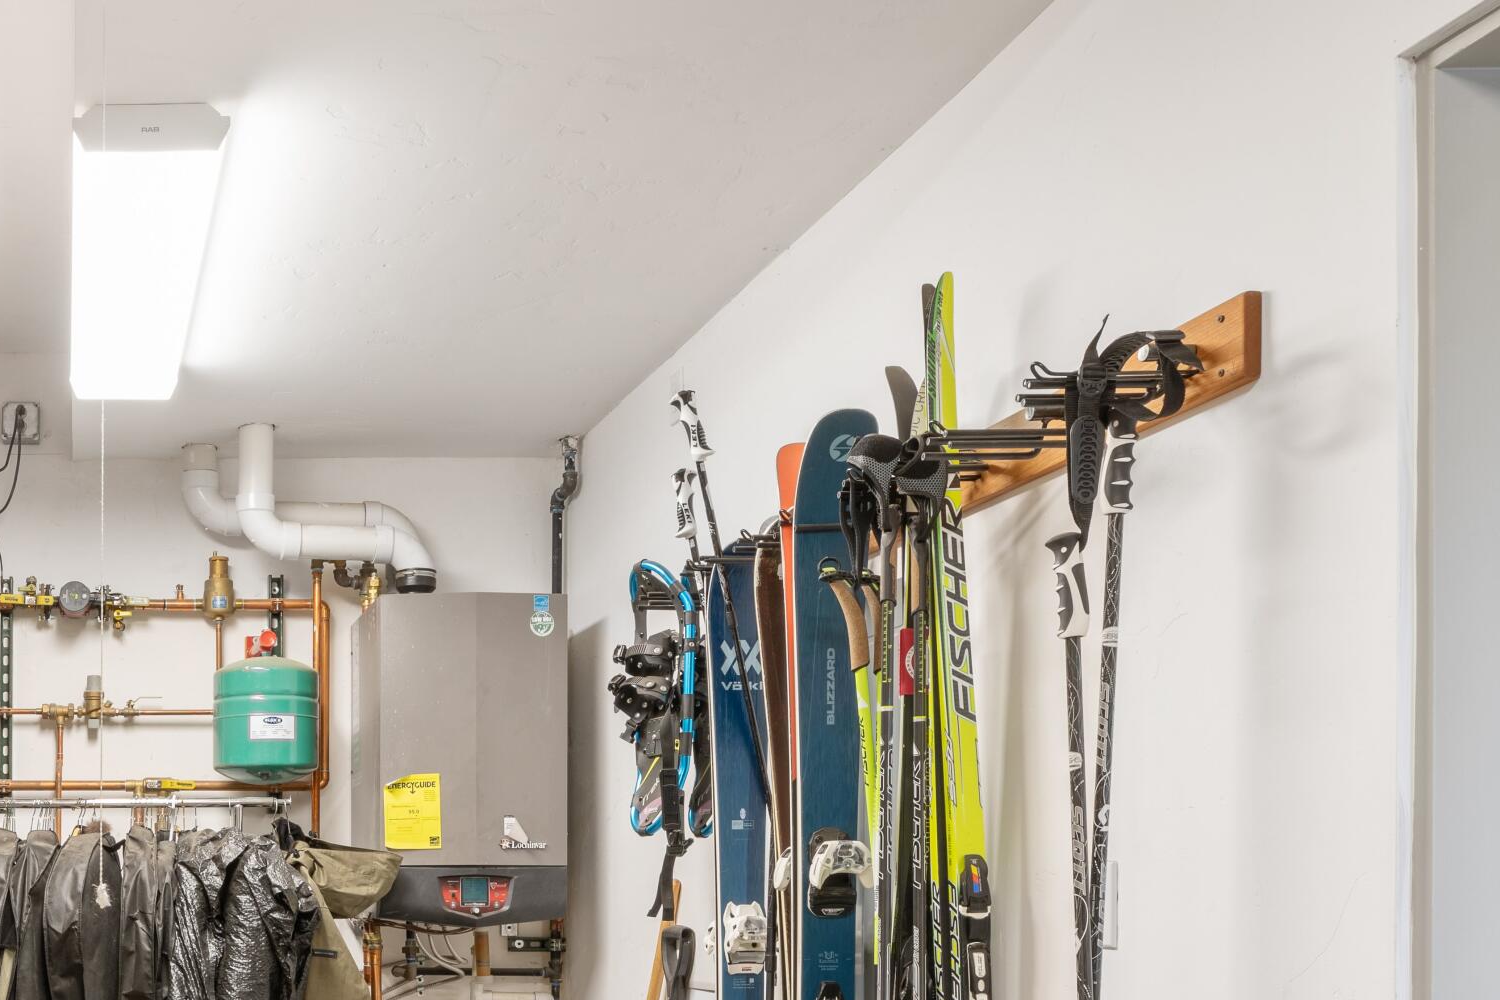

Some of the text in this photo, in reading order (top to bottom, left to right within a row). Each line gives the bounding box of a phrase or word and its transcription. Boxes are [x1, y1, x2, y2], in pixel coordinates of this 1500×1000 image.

[682, 502, 693, 524] LEKI
[940, 502, 977, 723] FISCHER
[721, 681, 764, 692] Vökl
[826, 647, 836, 726] BLIZZARD
[1096, 682, 1109, 773] SCOTT
[912, 759, 923, 890] FISCHER
[1071, 805, 1087, 896] SCOTT
